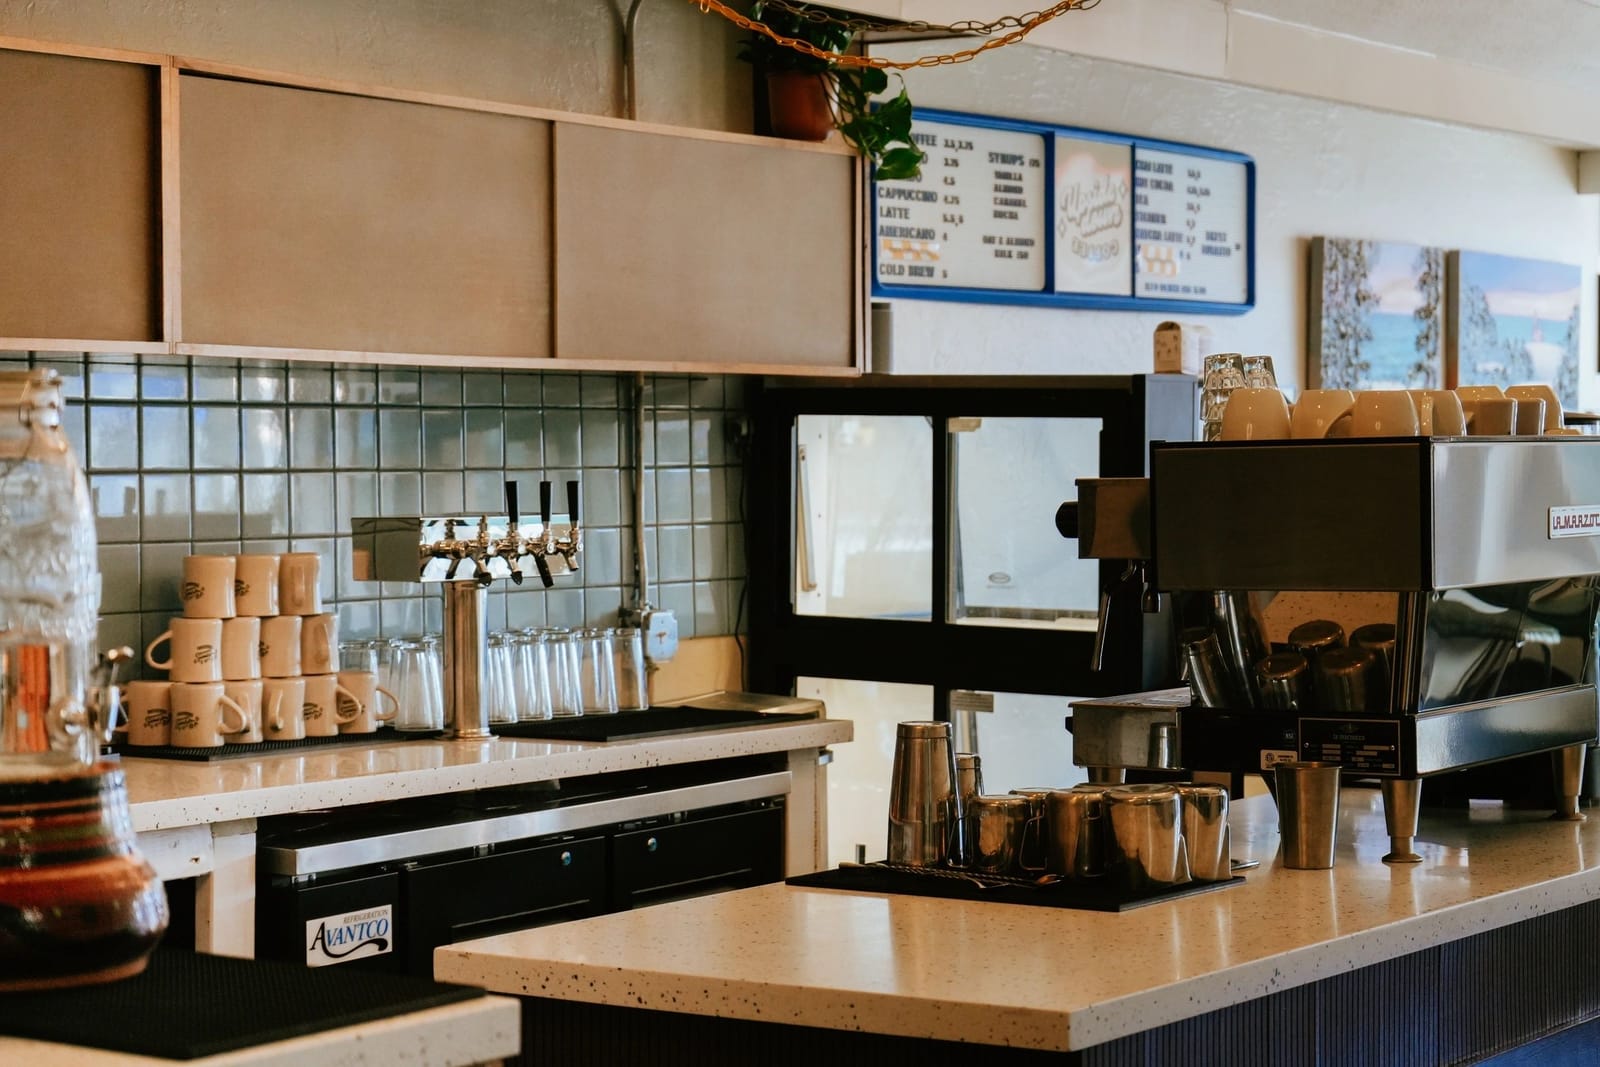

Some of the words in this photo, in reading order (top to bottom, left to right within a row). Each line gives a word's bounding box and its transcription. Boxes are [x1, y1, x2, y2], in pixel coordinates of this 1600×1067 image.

[988, 151, 1025, 167] SYRUPS
[878, 186, 939, 203] CAPPUCCINO
[879, 206, 910, 220] LATTE
[878, 225, 936, 240] AMERICANO
[879, 263, 905, 276] COLD
[908, 264, 935, 278] BREW
[309, 918, 389, 958] AVANTCO
